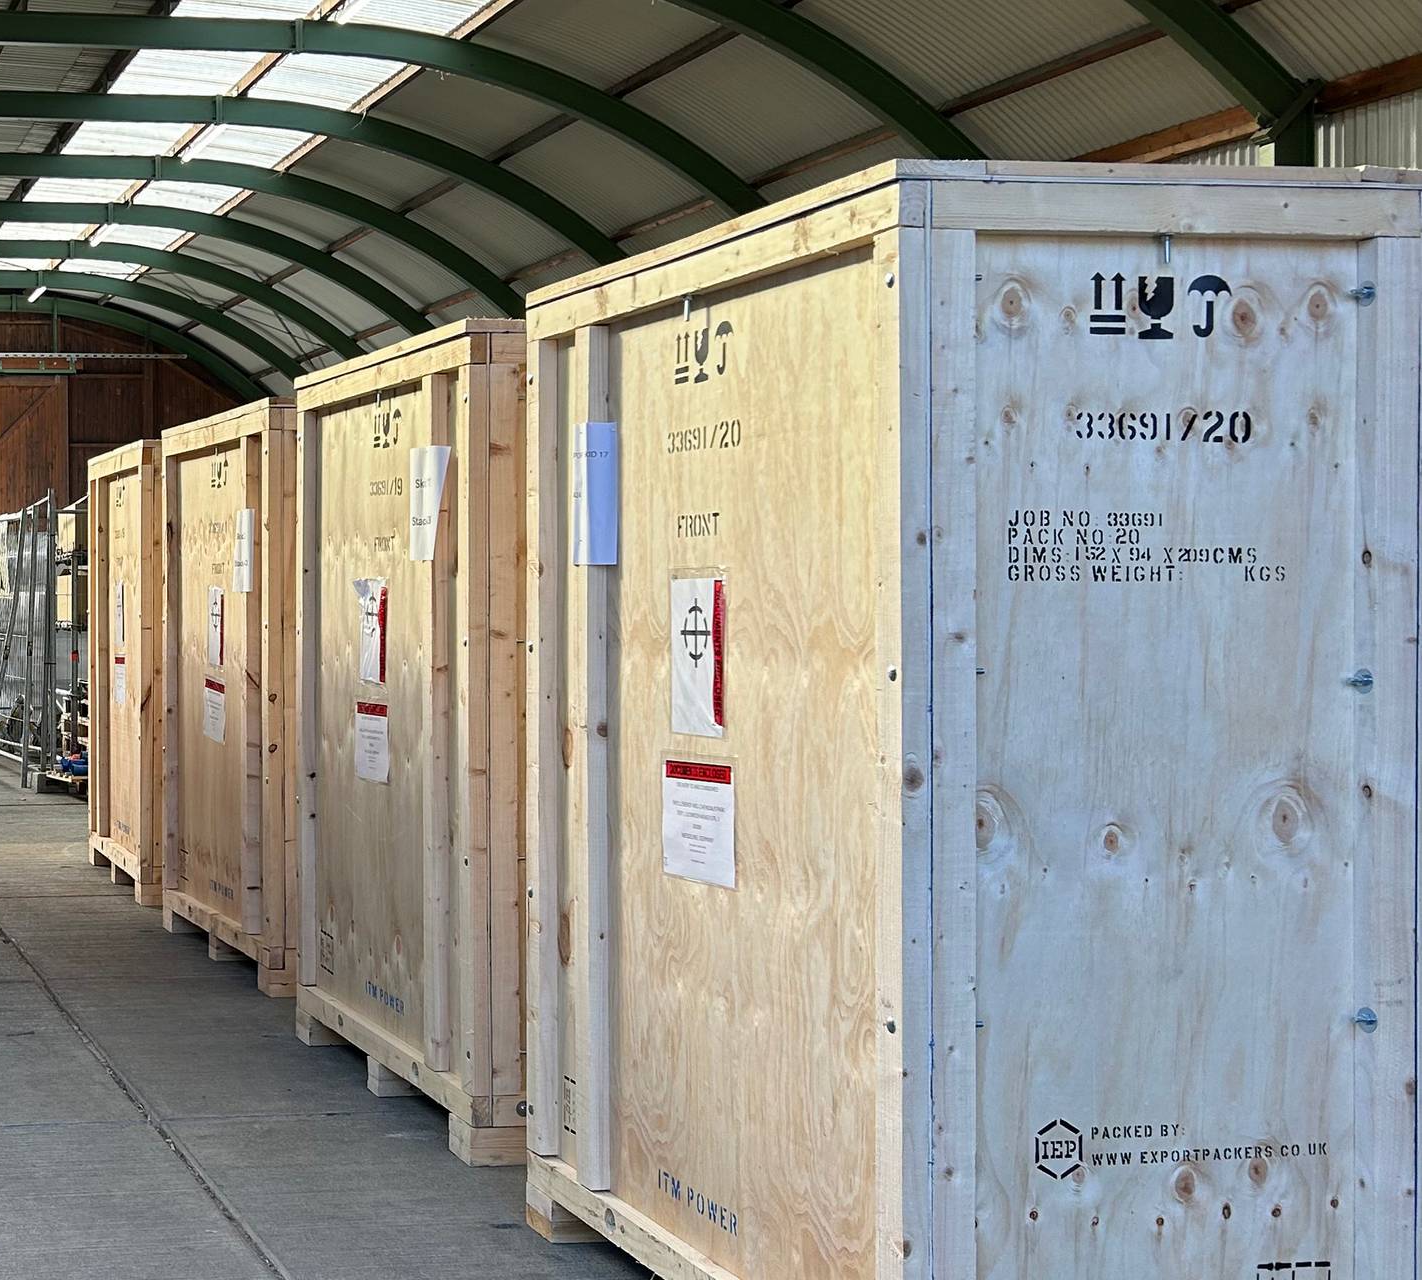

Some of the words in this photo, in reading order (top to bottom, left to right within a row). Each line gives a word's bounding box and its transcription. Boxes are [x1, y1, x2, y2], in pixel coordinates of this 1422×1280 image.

[667, 418, 741, 454] 33691/20
[1076, 411, 1251, 443] 33691/20
[370, 476, 403, 496] 33691/19
[677, 512, 720, 538] FRONT
[1008, 510, 1050, 527] JOB
[1107, 512, 1163, 527] 33691
[1008, 528, 1064, 545] PACK
[1008, 565, 1080, 581] GROSS
[1244, 565, 1286, 581] KGS
[1091, 1124, 1153, 1140] PACKED
[1041, 1140, 1077, 1160] IEP
[658, 1168, 681, 1201] ITM
[686, 1185, 738, 1237] POWER
